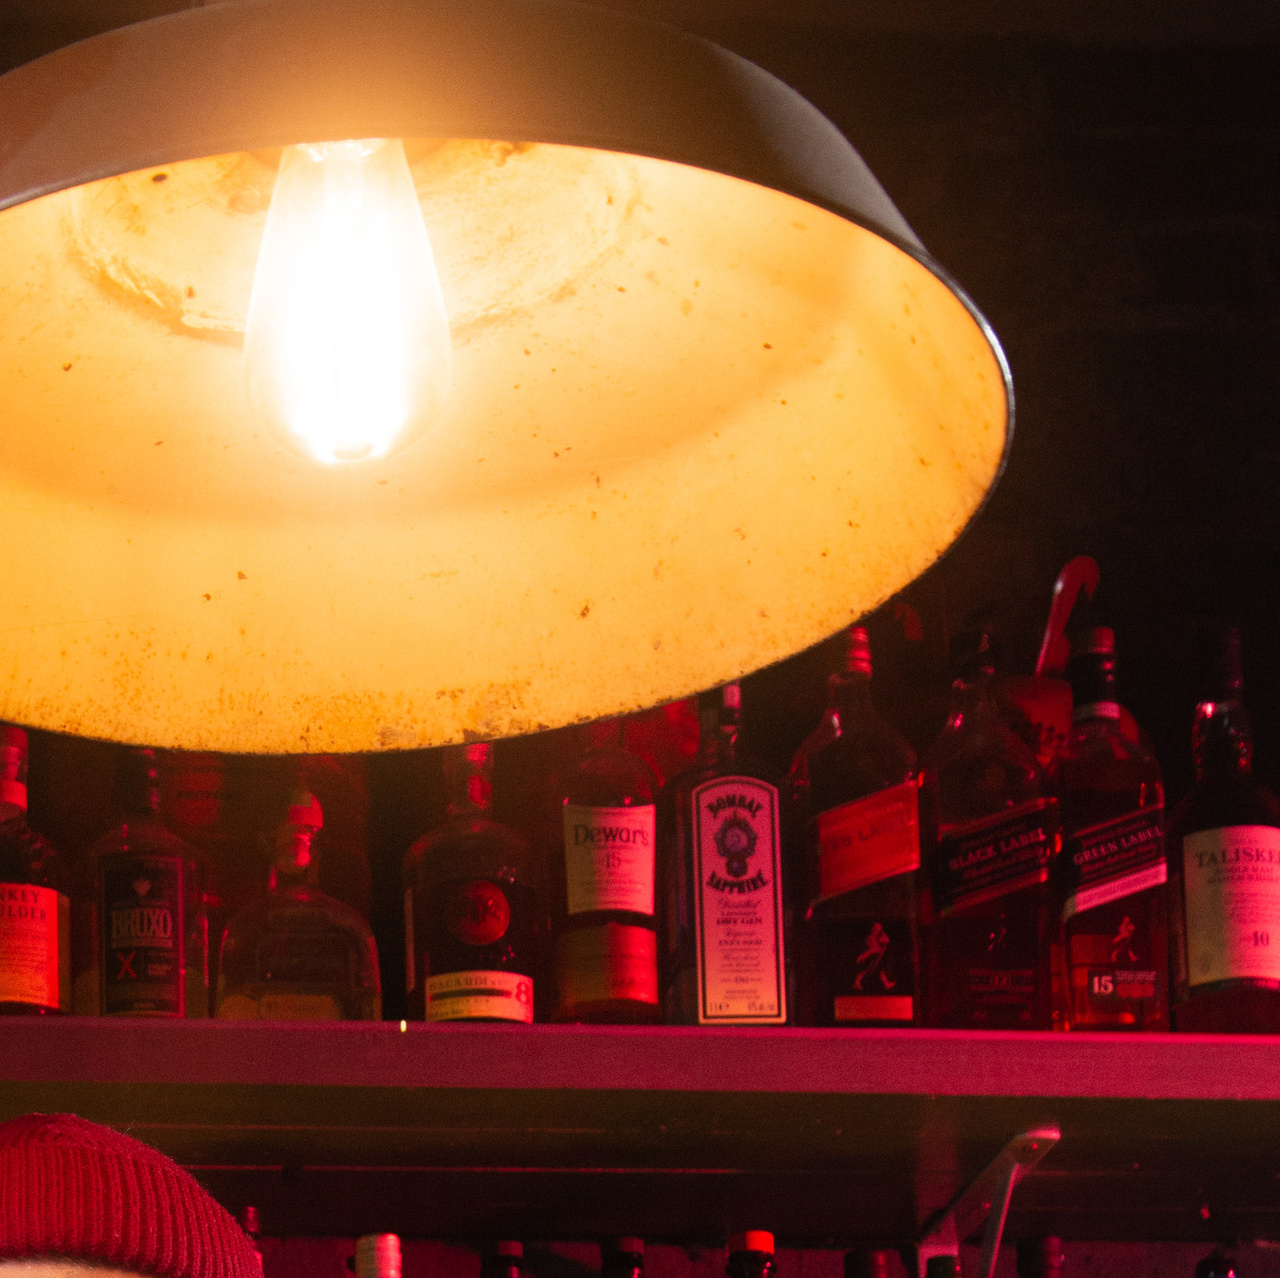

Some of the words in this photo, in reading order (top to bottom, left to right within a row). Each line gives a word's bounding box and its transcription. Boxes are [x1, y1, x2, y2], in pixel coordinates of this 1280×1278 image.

[707, 794, 763, 818] BOMBAY
[1000, 827, 1046, 853] LABEL
[1073, 841, 1118, 865] GREEN
[1120, 826, 1164, 848] LABEL
[1194, 848, 1280, 869] TALISKE
[706, 869, 768, 894] SAPPHIRE
[111, 908, 173, 938] BRUXO
[515, 982, 529, 1005] 8
[1093, 975, 1114, 995] 15
